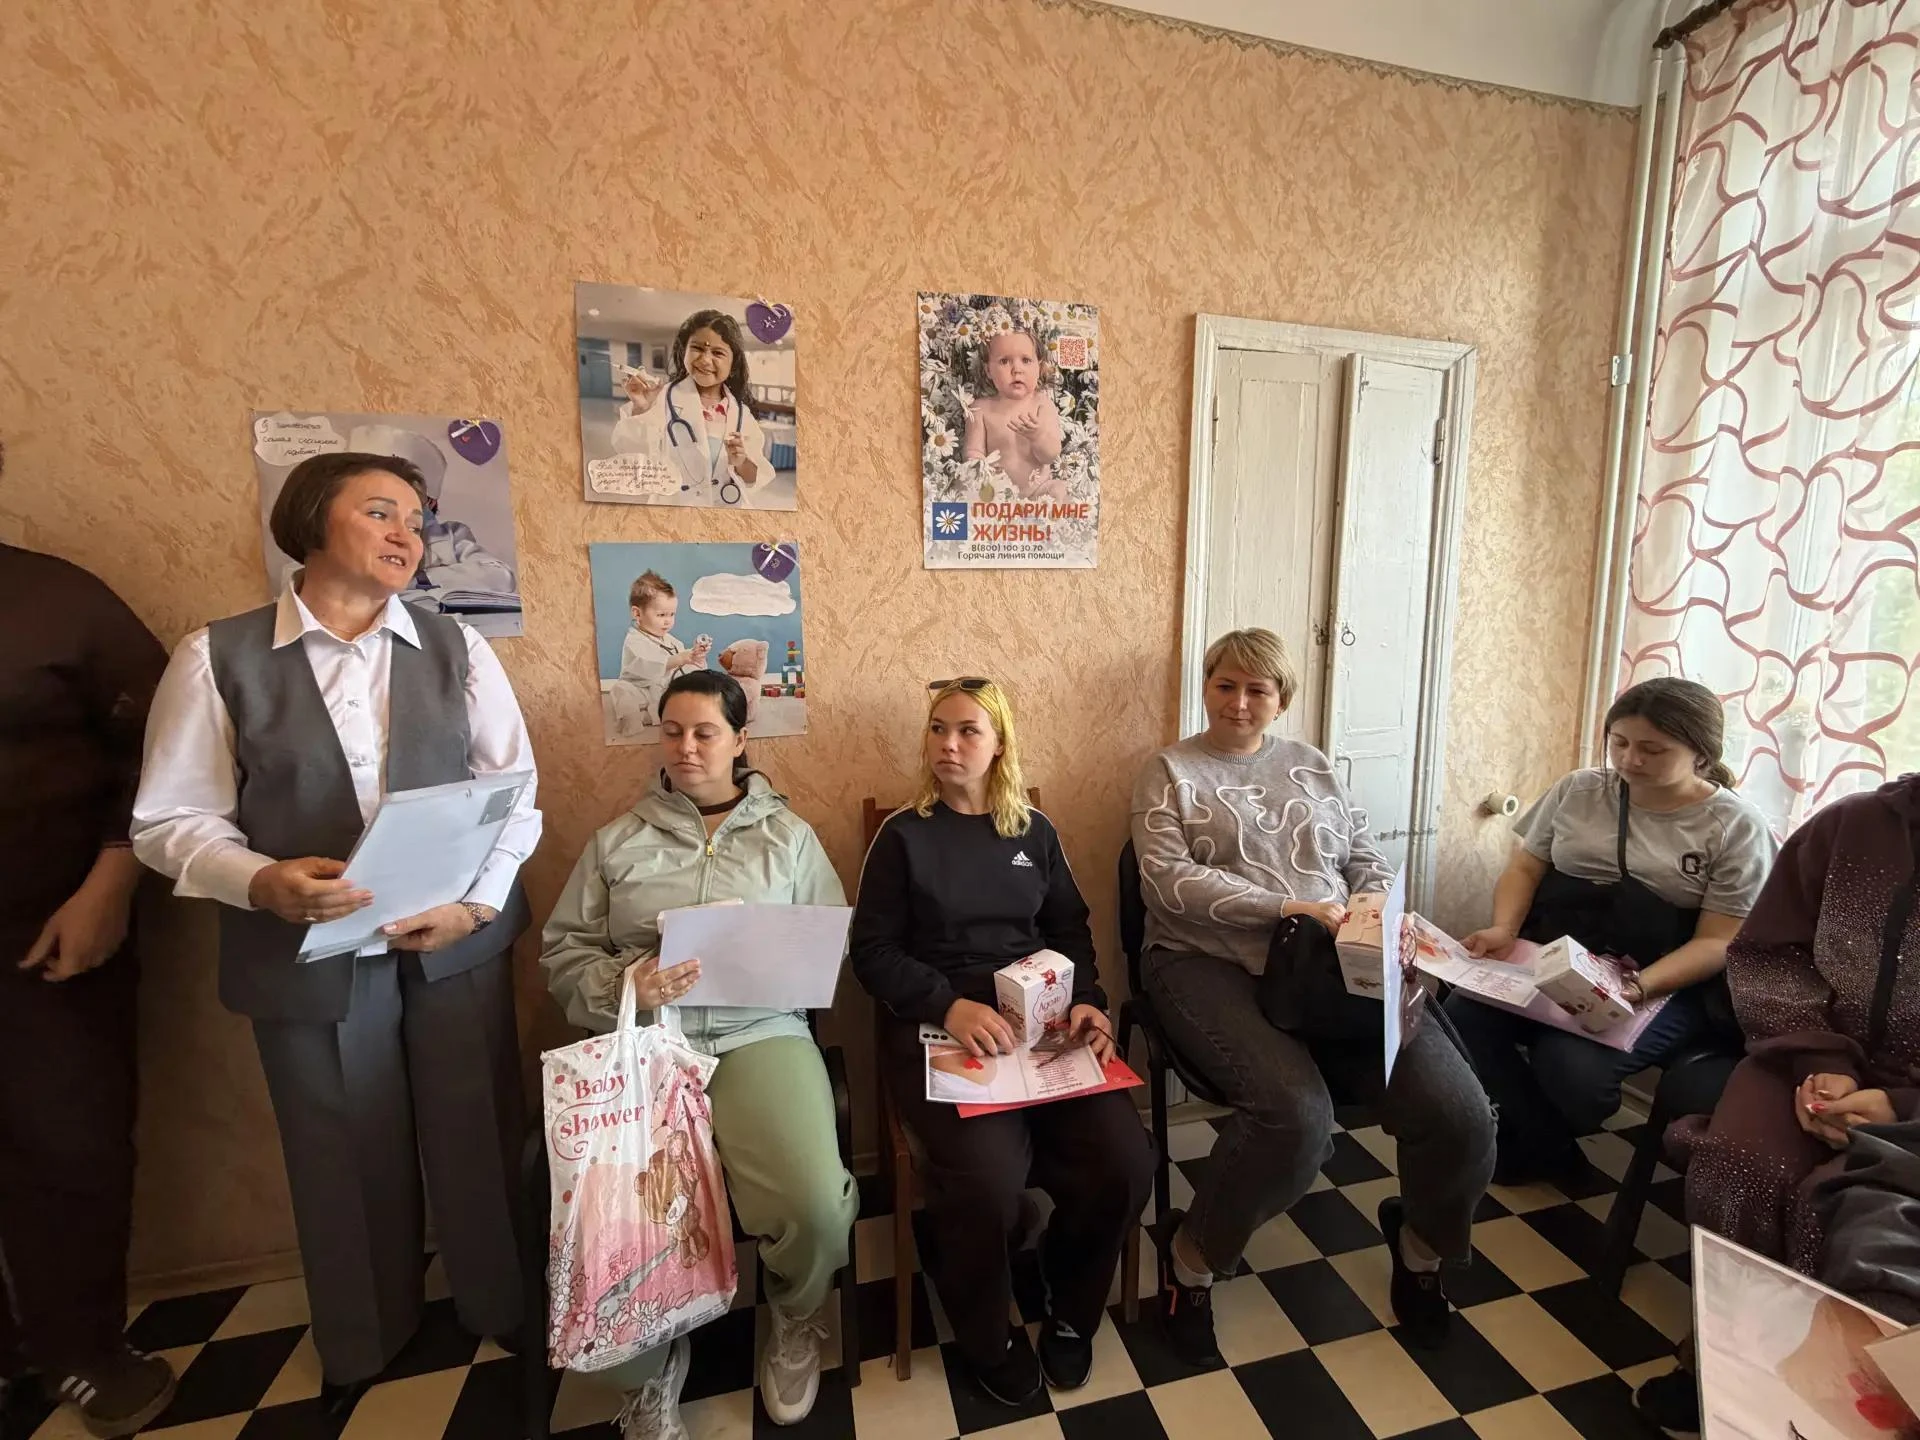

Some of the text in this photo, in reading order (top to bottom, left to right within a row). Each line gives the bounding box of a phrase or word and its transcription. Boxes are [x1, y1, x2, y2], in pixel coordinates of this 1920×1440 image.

[972, 502, 1089, 521] ПОДАРИ МНЕ
[973, 524, 1052, 542] ЖИЗНЬ!
[957, 552, 995, 561] Горячая
[971, 544, 1001, 552] 8(800)
[575, 1071, 629, 1100] Baby
[560, 1104, 645, 1140] shower
